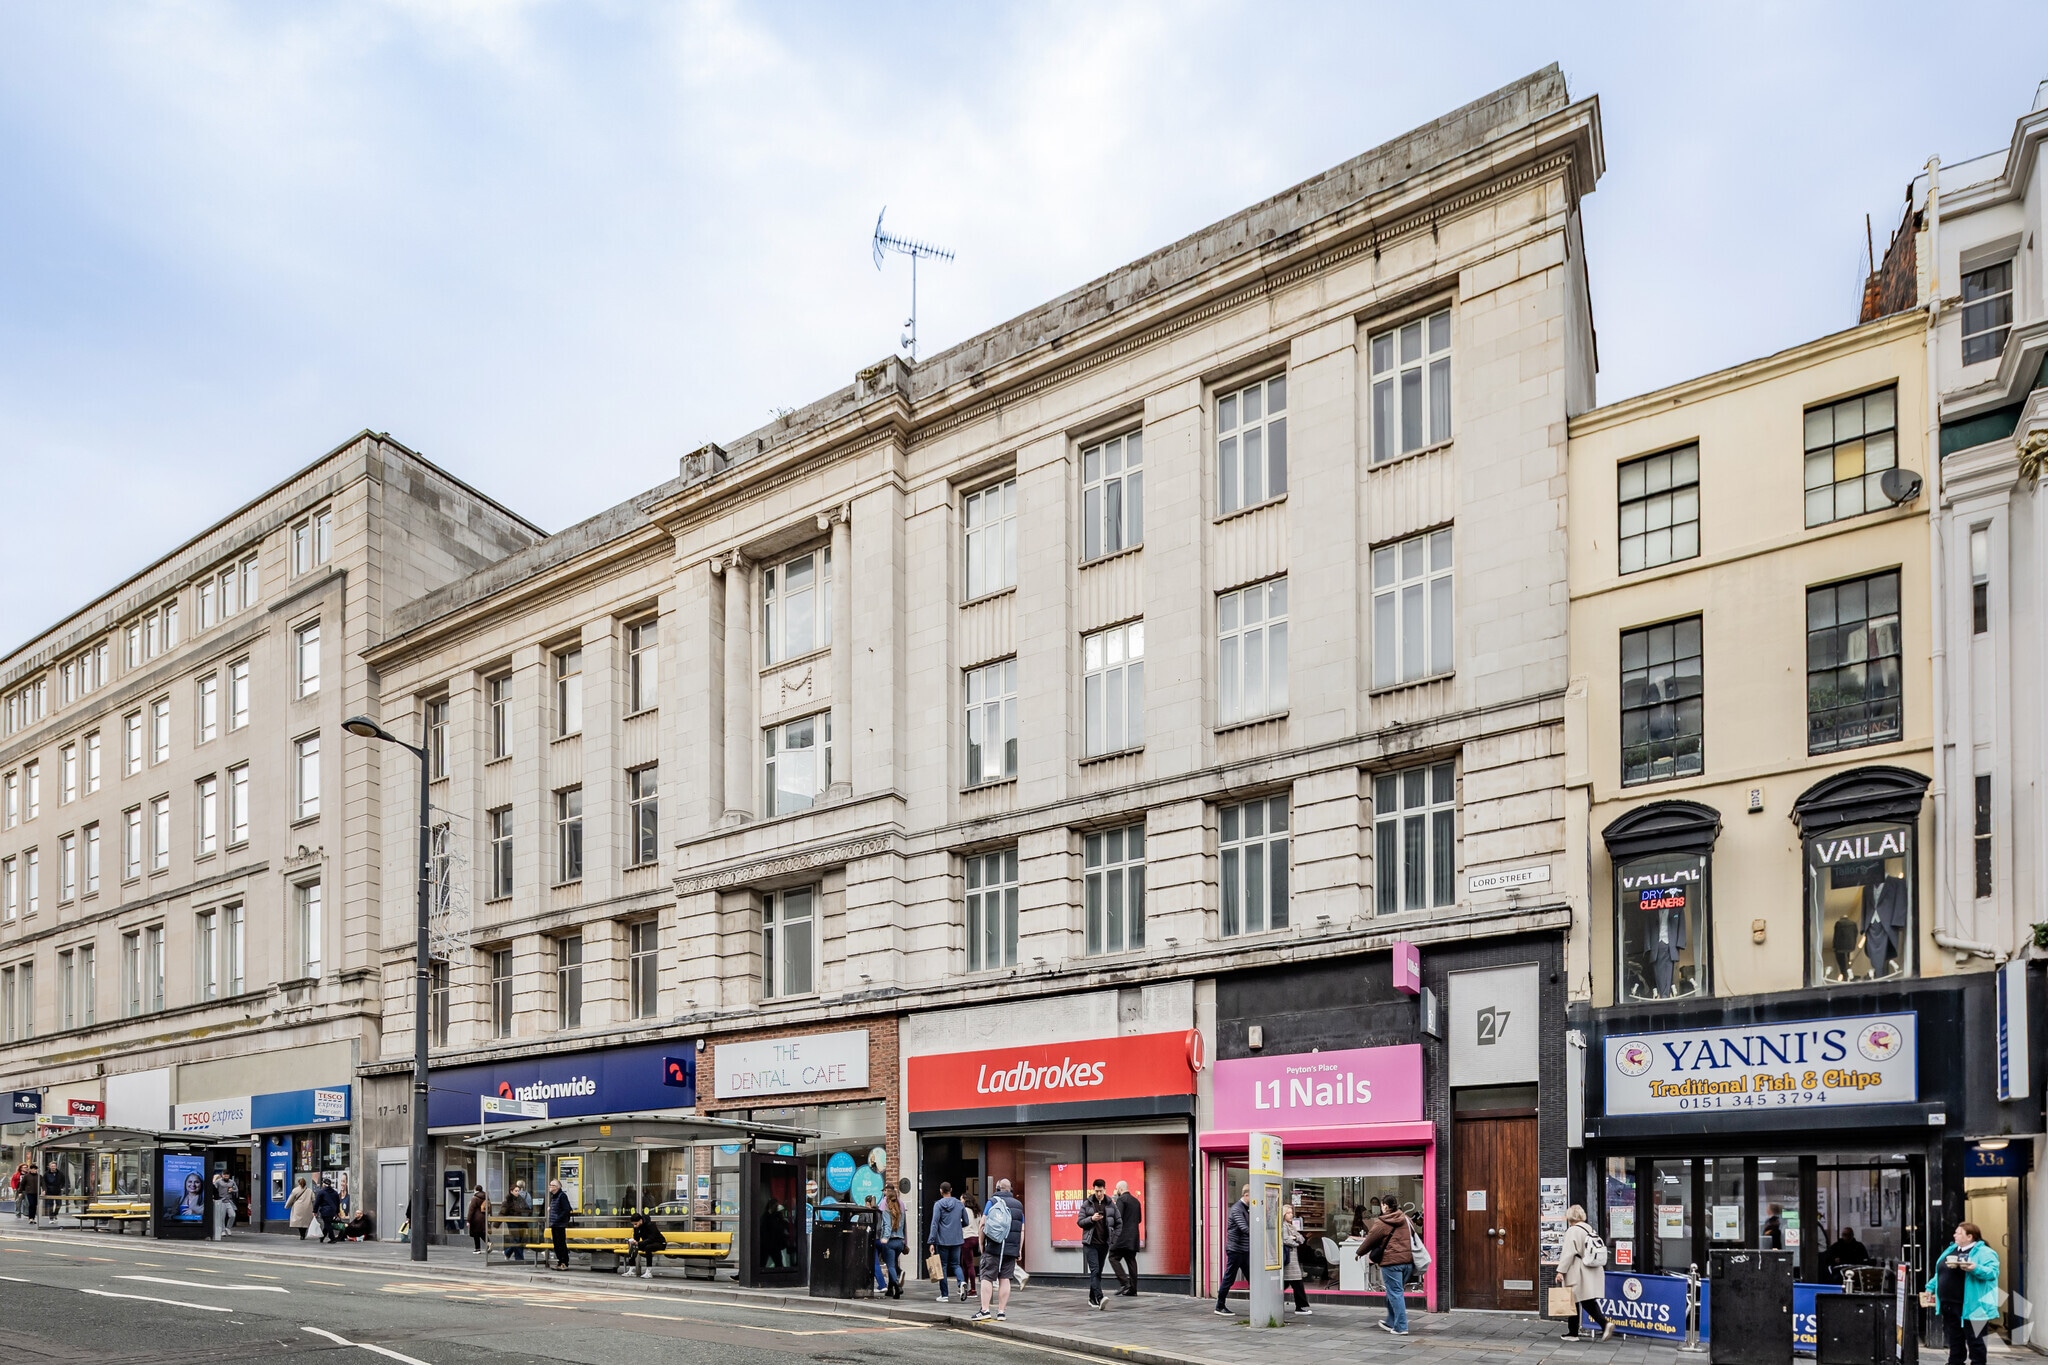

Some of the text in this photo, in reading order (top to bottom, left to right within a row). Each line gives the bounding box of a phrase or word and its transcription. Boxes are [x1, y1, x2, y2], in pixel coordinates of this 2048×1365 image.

[1473, 877, 1497, 888] LORD
[1499, 872, 1533, 884] STREET
[1640, 896, 1685, 910] CLEANERS
[1641, 888, 1665, 901] DRY
[1479, 1010, 1511, 1039] 27
[772, 1043, 801, 1061] THE
[1662, 1029, 1847, 1072] YANNI'S
[731, 1063, 847, 1091] DENTAL CAFE
[976, 1056, 1107, 1094] Ladbrokes
[1286, 1063, 1338, 1075] Peyton's Place
[514, 1075, 596, 1101] nationwide
[1255, 1072, 1372, 1110] L1 Nails
[1649, 1069, 1883, 1098] Traditional Fish & Chips
[317, 1092, 343, 1100] TESCO
[1679, 1091, 1827, 1109] 0151 345 3794
[317, 1101, 343, 1109] express
[182, 1109, 244, 1126] TESCO express
[1975, 1152, 2004, 1167] 33a
[1054, 1190, 1065, 1200] WE
[1055, 1200, 1074, 1210] EVERY
[1595, 1298, 1670, 1322] YANNI'S
[1629, 1319, 1646, 1329] Fish
[1646, 1321, 1654, 1330] &
[1654, 1322, 1676, 1334] Chips
